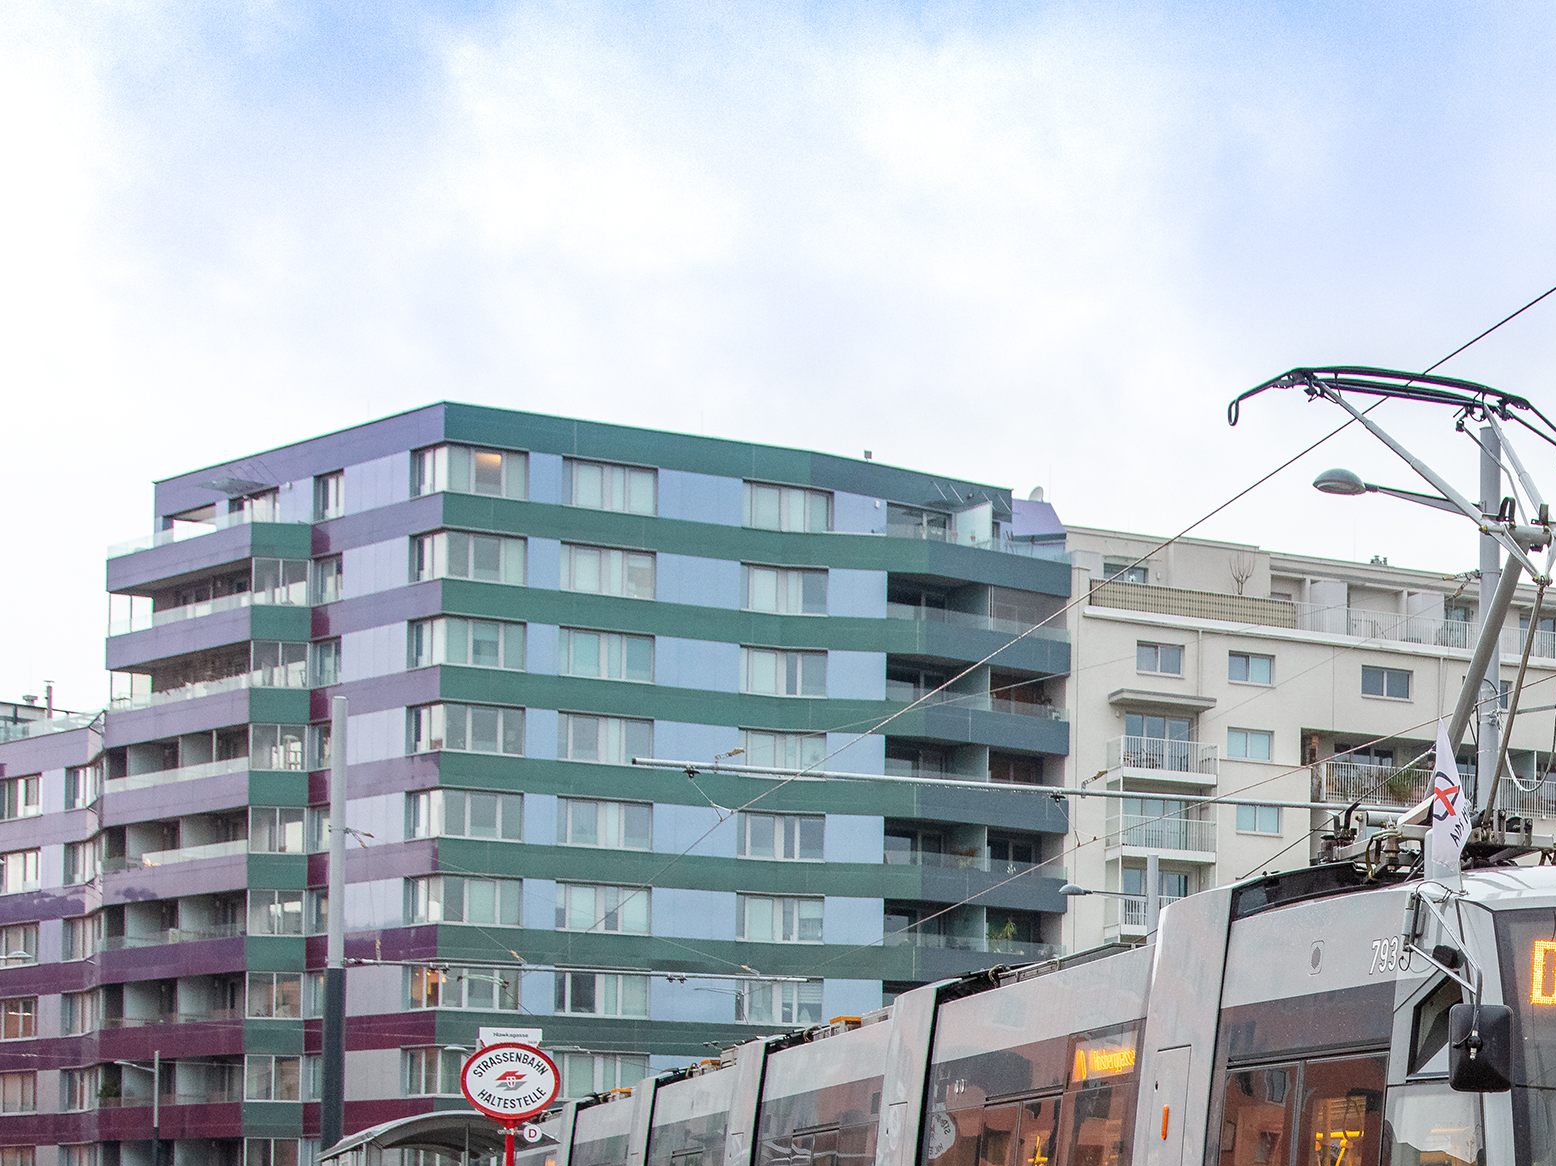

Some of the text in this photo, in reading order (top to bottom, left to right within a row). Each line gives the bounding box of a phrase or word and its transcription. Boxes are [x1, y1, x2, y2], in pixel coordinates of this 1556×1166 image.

[1369, 936, 1399, 975] 793
[473, 1052, 549, 1078] STRASSENBAHN
[477, 1087, 547, 1108] HALTESTELLE
[528, 1128, 537, 1138] D
